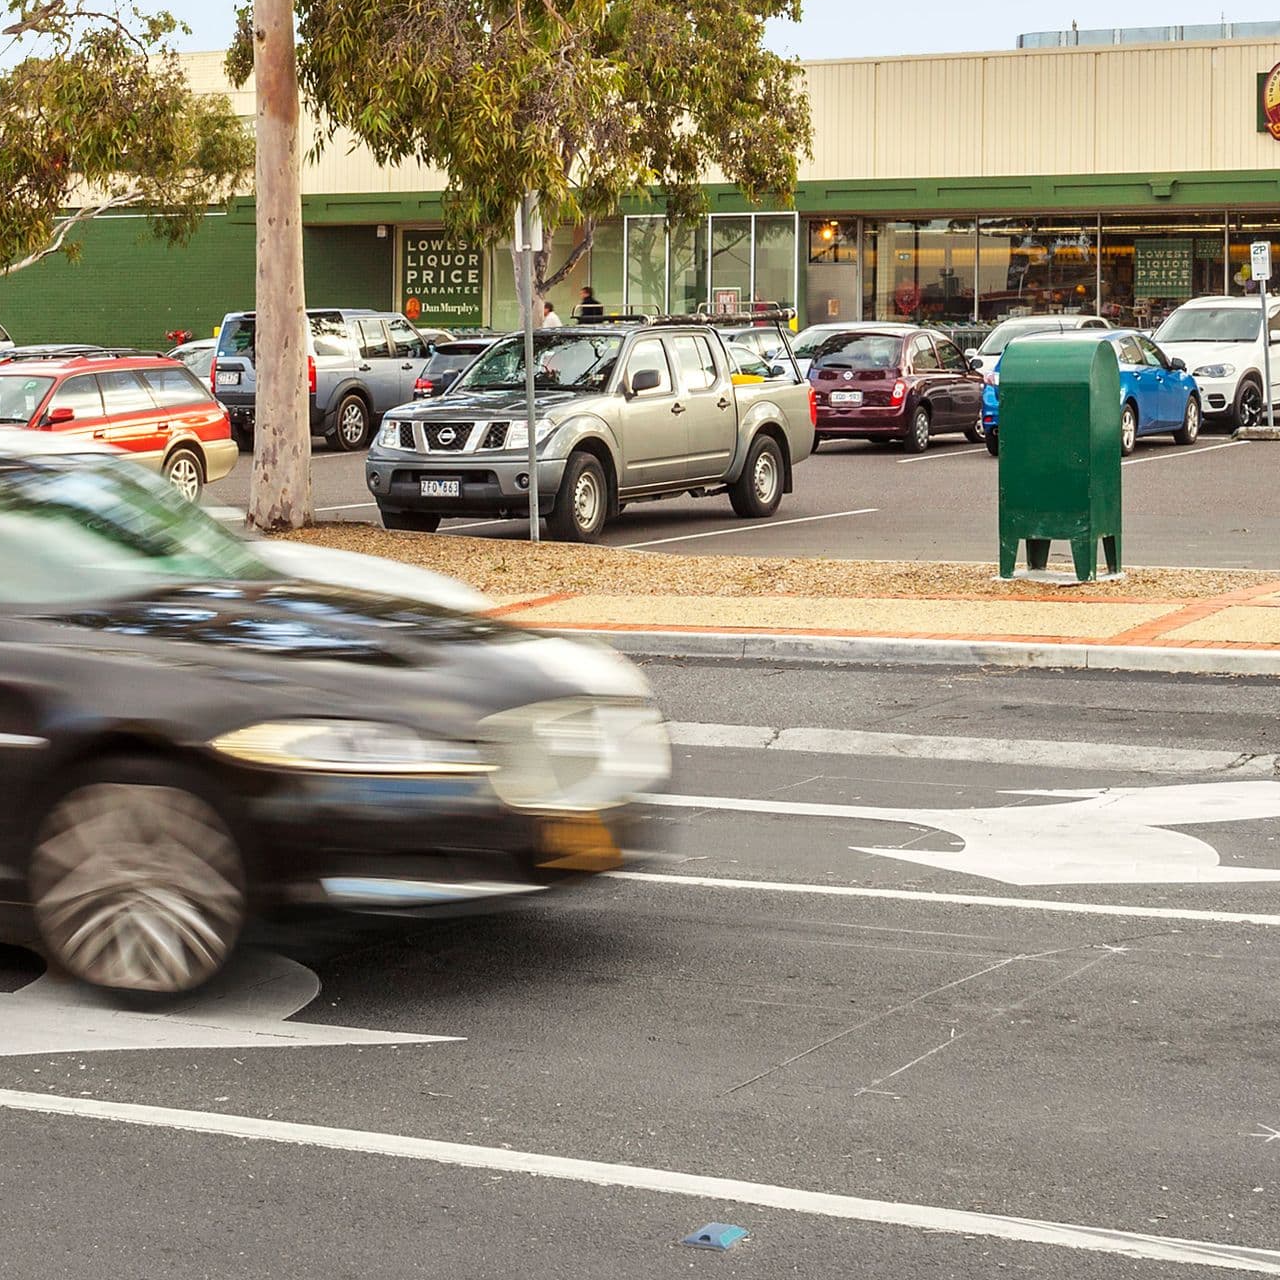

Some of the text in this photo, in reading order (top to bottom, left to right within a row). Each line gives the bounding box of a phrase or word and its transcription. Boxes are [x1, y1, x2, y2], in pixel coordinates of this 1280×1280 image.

[1137, 250, 1190, 259] LOWEST
[1252, 245, 1266, 255] 2P
[407, 254, 479, 267] LIQUOR
[1137, 260, 1190, 269] LIQUOR
[407, 270, 479, 283] PRICE
[1137, 270, 1190, 279] PRICE
[406, 286, 479, 294] GUARANTEE
[422, 303, 479, 315] Dan Murphy's
